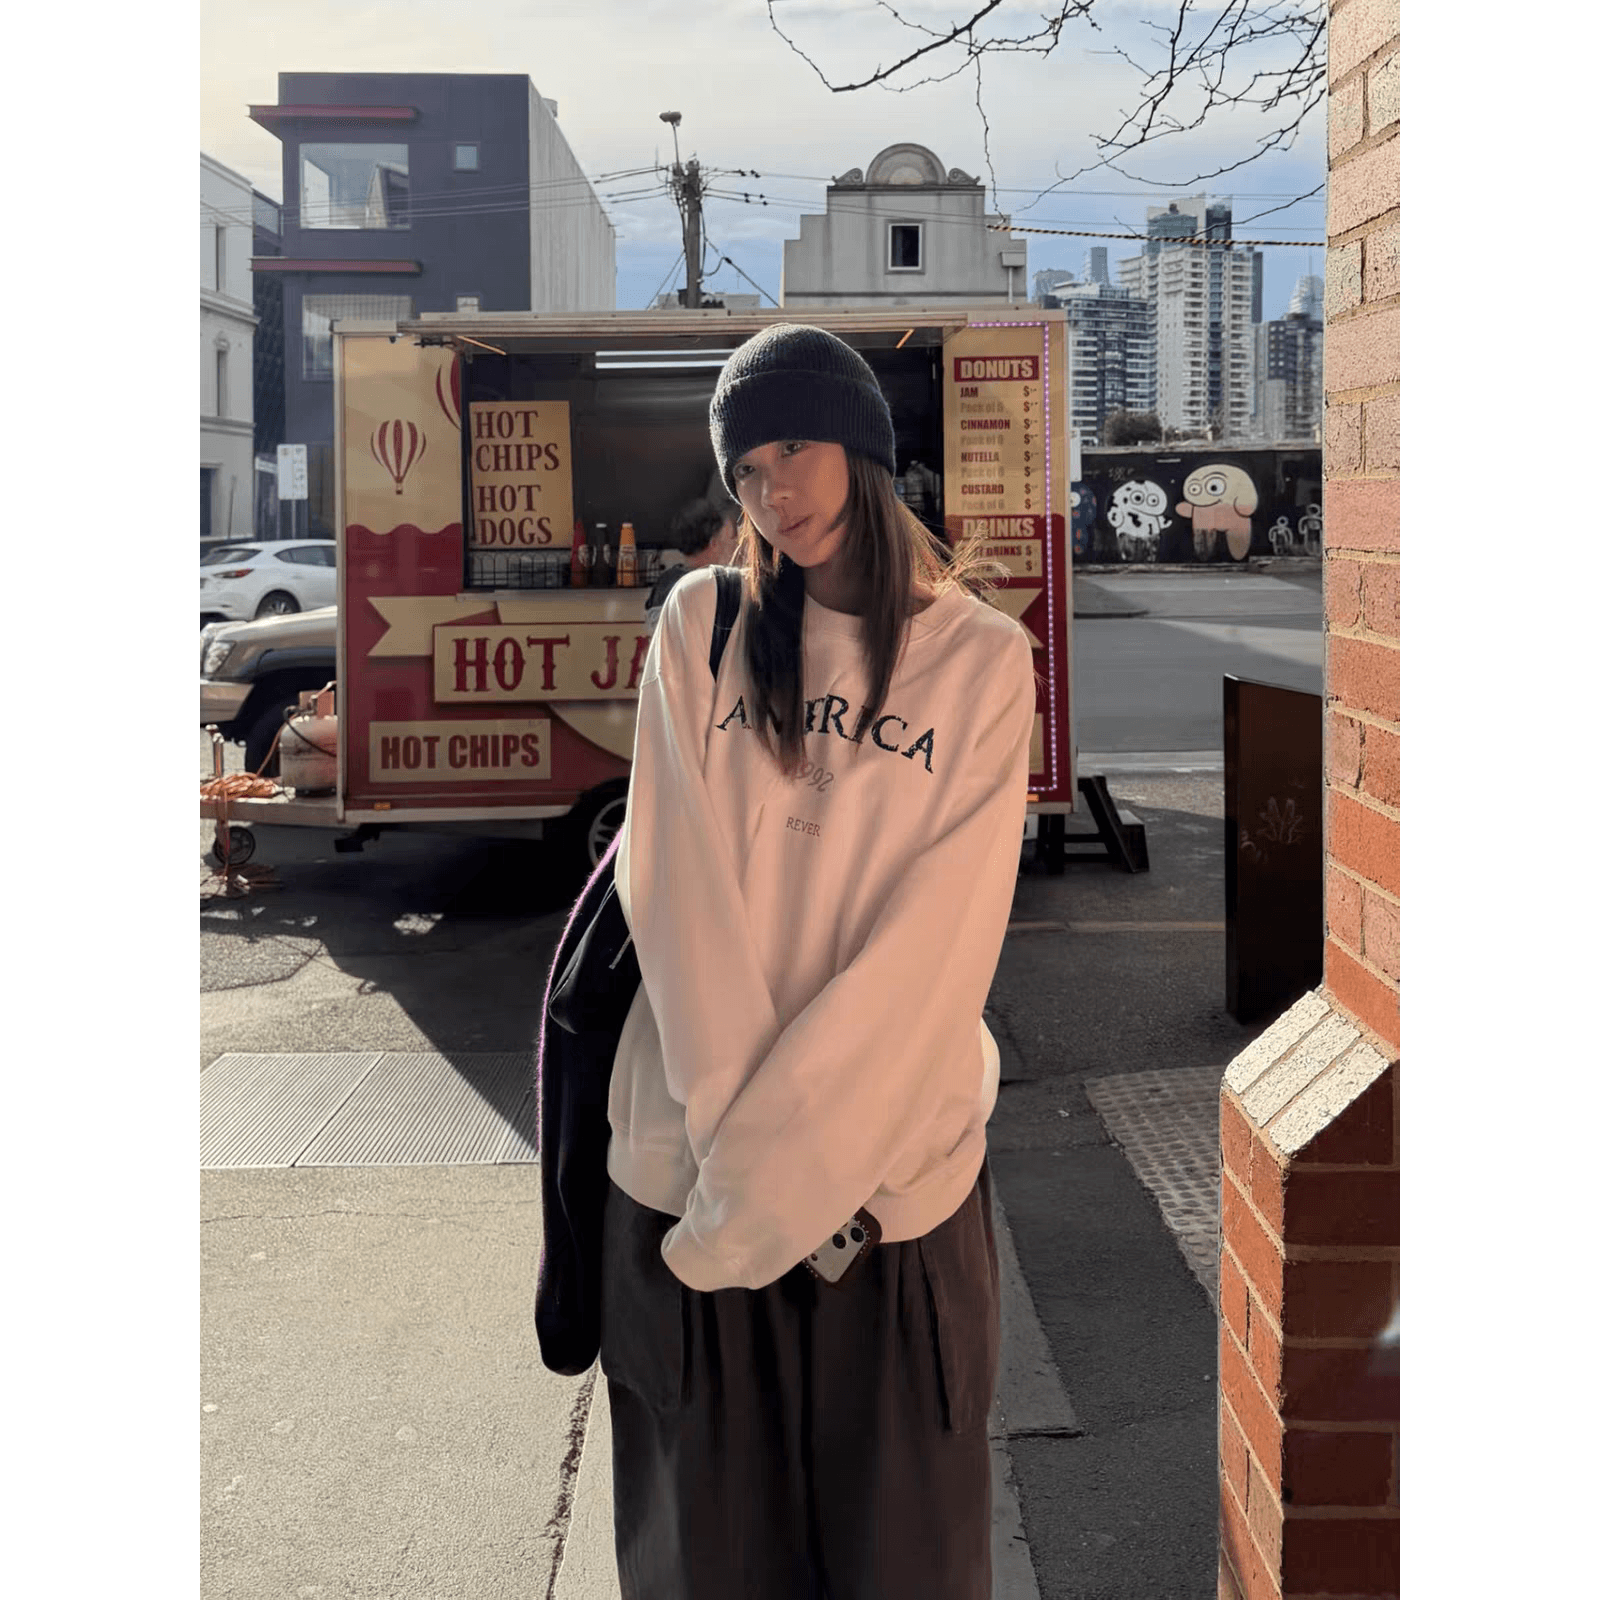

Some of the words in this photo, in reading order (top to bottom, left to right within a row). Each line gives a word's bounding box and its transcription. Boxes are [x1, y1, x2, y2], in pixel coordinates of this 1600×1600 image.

[960, 359, 1034, 379] DONUTS
[960, 387, 979, 398] JAM
[474, 410, 539, 438] HOT
[960, 419, 1011, 430] CINNAMON
[476, 443, 560, 472] CHIPS
[961, 451, 1000, 462] NUTELLA
[476, 484, 542, 512] HOT
[961, 484, 1004, 495] CUSTARD
[479, 517, 552, 545] DOGS
[961, 518, 1036, 538] DRINKS
[986, 545, 1022, 556] DRINKS
[452, 634, 570, 692] HOT
[381, 736, 441, 769] HOT
[448, 733, 541, 769] CHIPS
[786, 816, 821, 837] REVER
